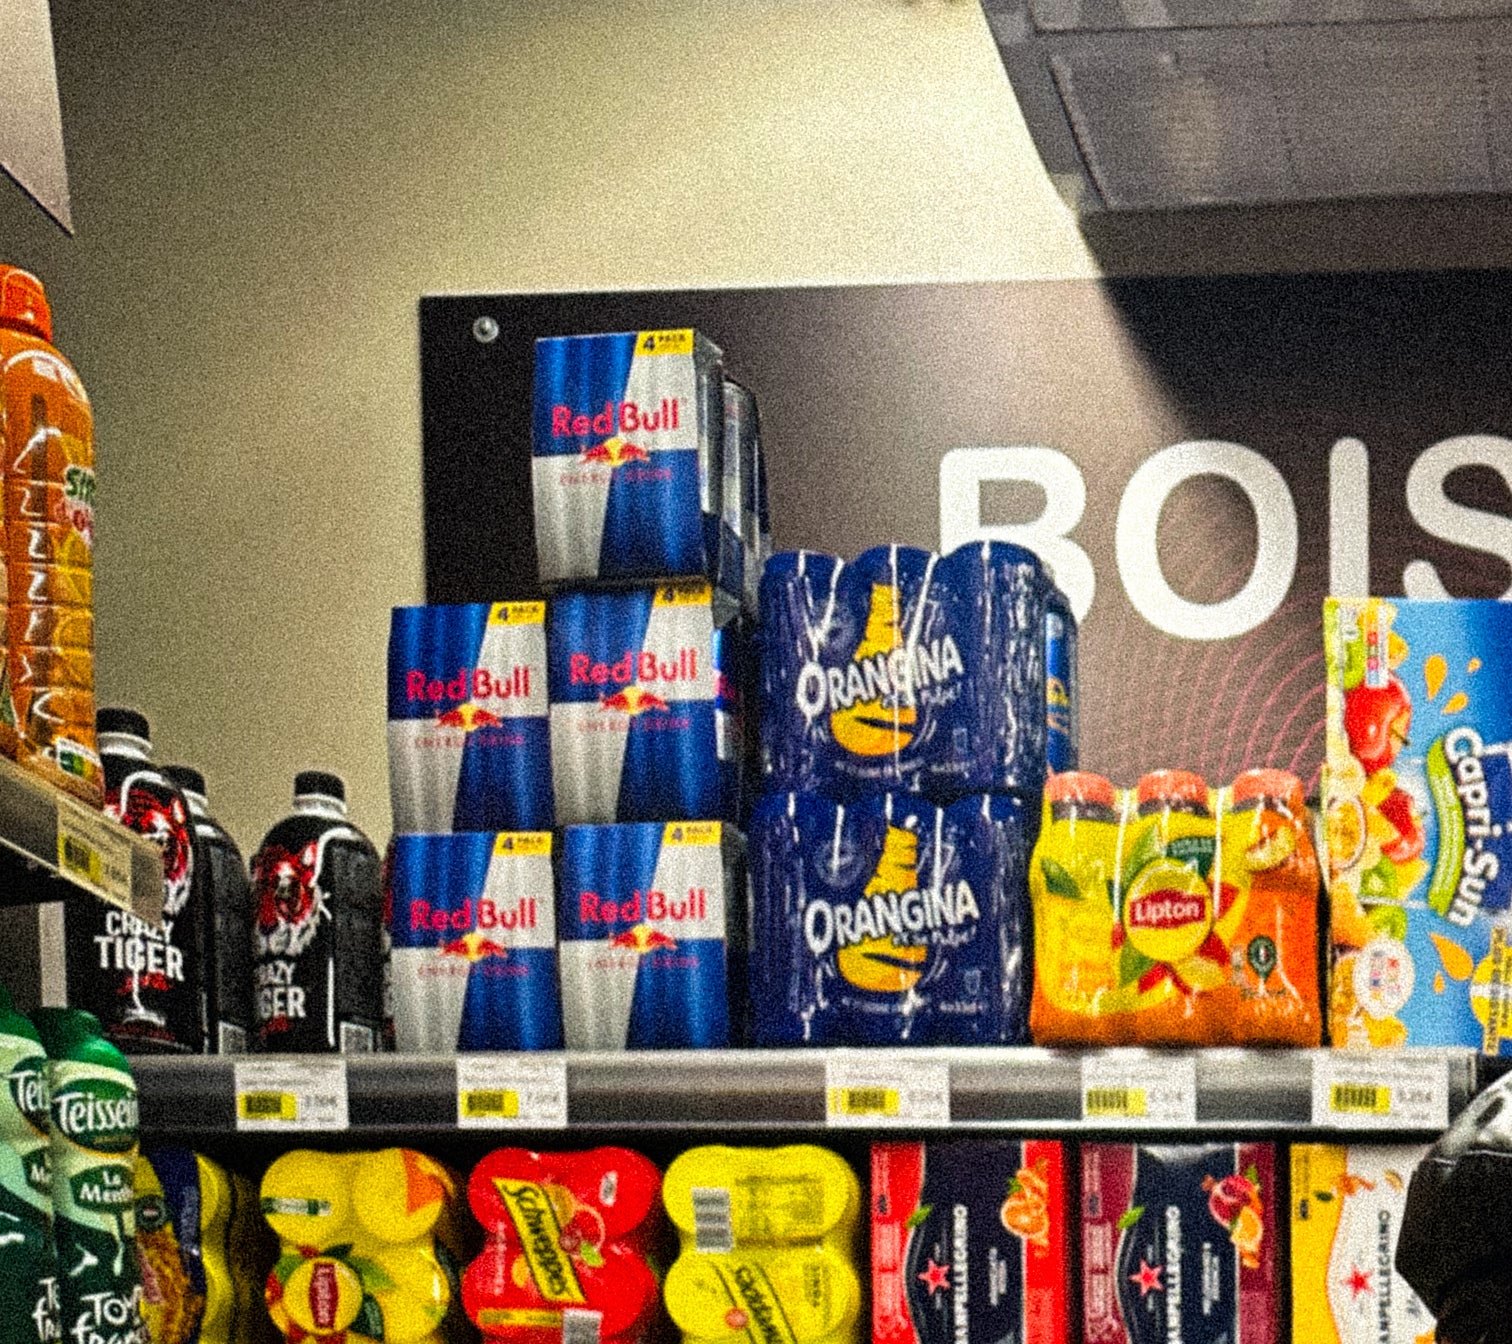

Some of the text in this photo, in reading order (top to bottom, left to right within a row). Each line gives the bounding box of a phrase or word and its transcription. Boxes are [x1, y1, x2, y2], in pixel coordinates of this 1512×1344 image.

[551, 398, 679, 438] Red Bull
[405, 665, 531, 702] Red Bull
[569, 648, 698, 685] Red Bull
[799, 633, 964, 722] ORANGINA
[1443, 726, 1503, 927] Capri-Sun
[409, 896, 537, 931] Red Bull
[579, 888, 707, 924] Red Bull
[803, 879, 981, 954] ORANGINA
[1134, 894, 1206, 931] Lipton
[93, 935, 185, 982] TIGER
